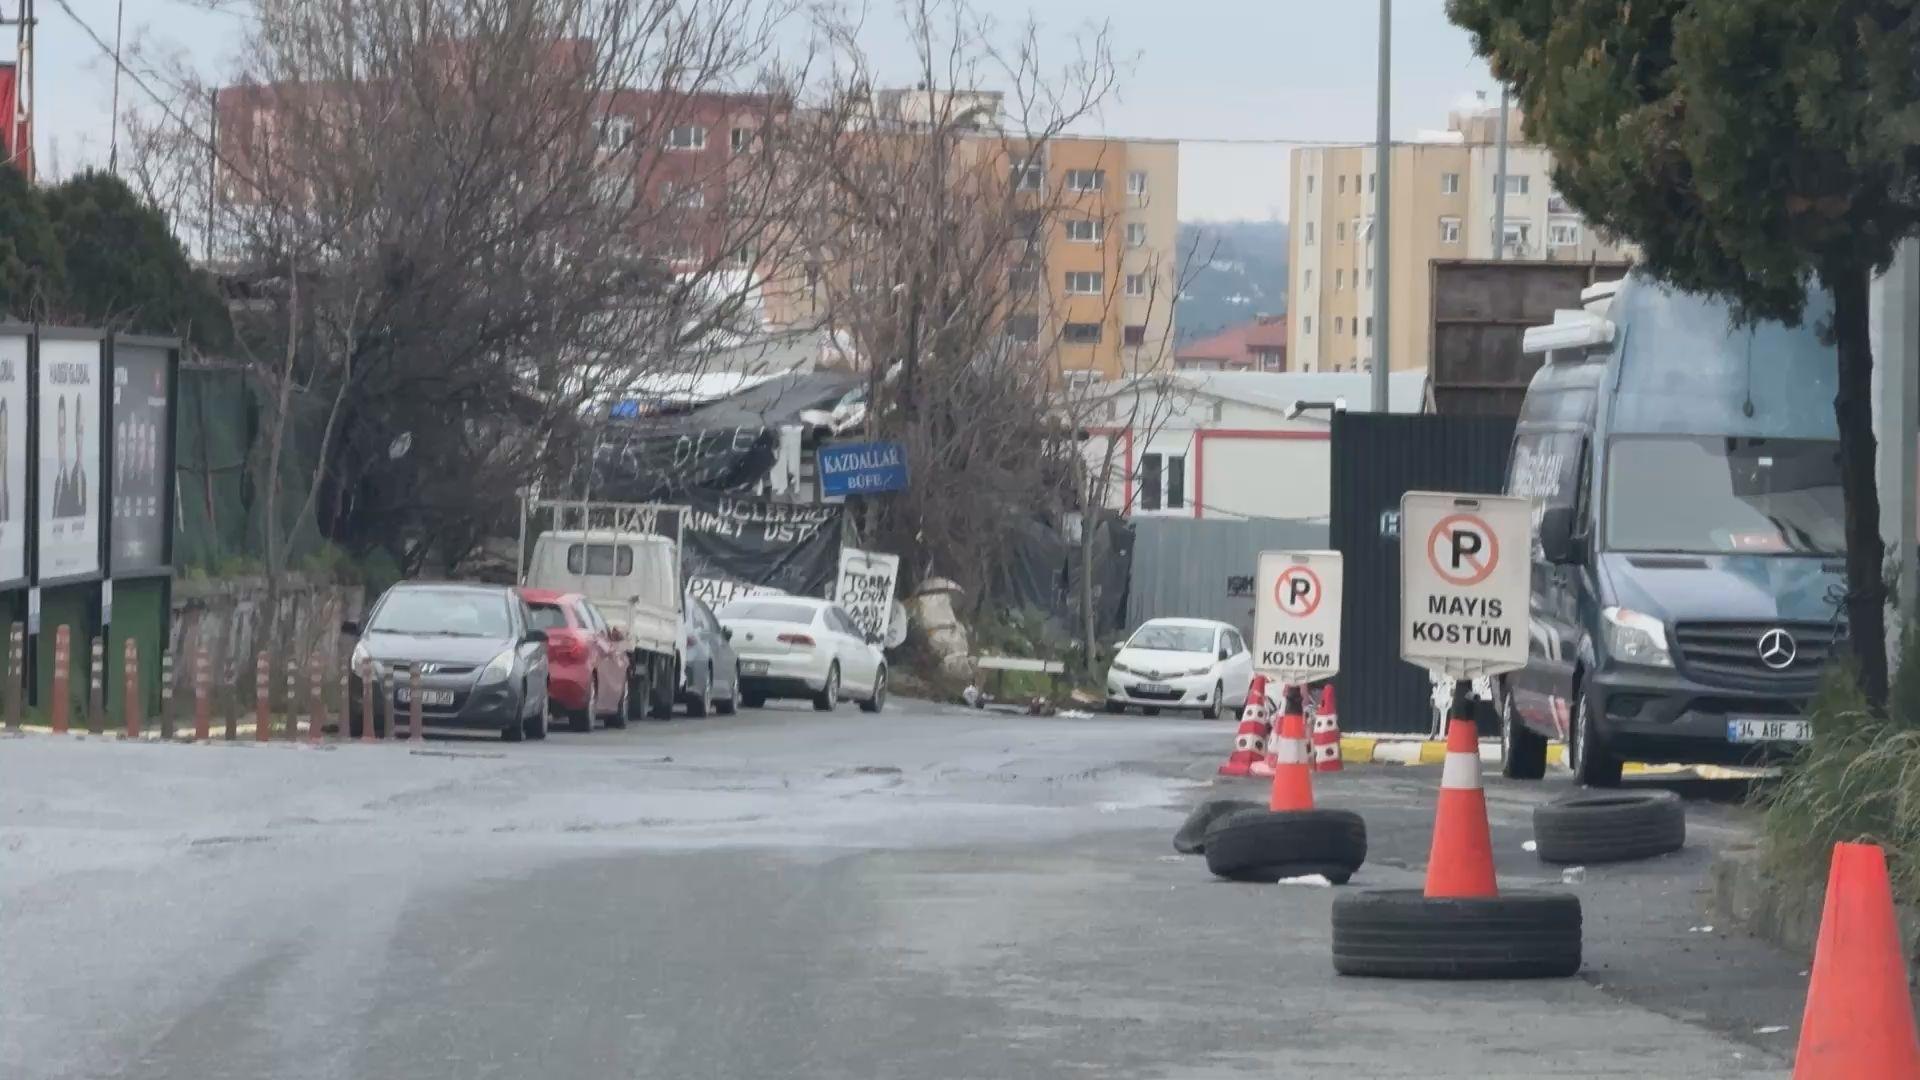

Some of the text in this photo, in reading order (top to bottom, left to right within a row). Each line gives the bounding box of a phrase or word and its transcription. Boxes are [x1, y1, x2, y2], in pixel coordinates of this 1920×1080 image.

[1451, 529, 1482, 569] P
[1289, 577, 1311, 606] P
[1428, 594, 1503, 619] MAYIS
[1274, 631, 1325, 648] MAYIS
[1412, 620, 1512, 648] KOSTÜM
[1262, 648, 1331, 668] KOSTÜM
